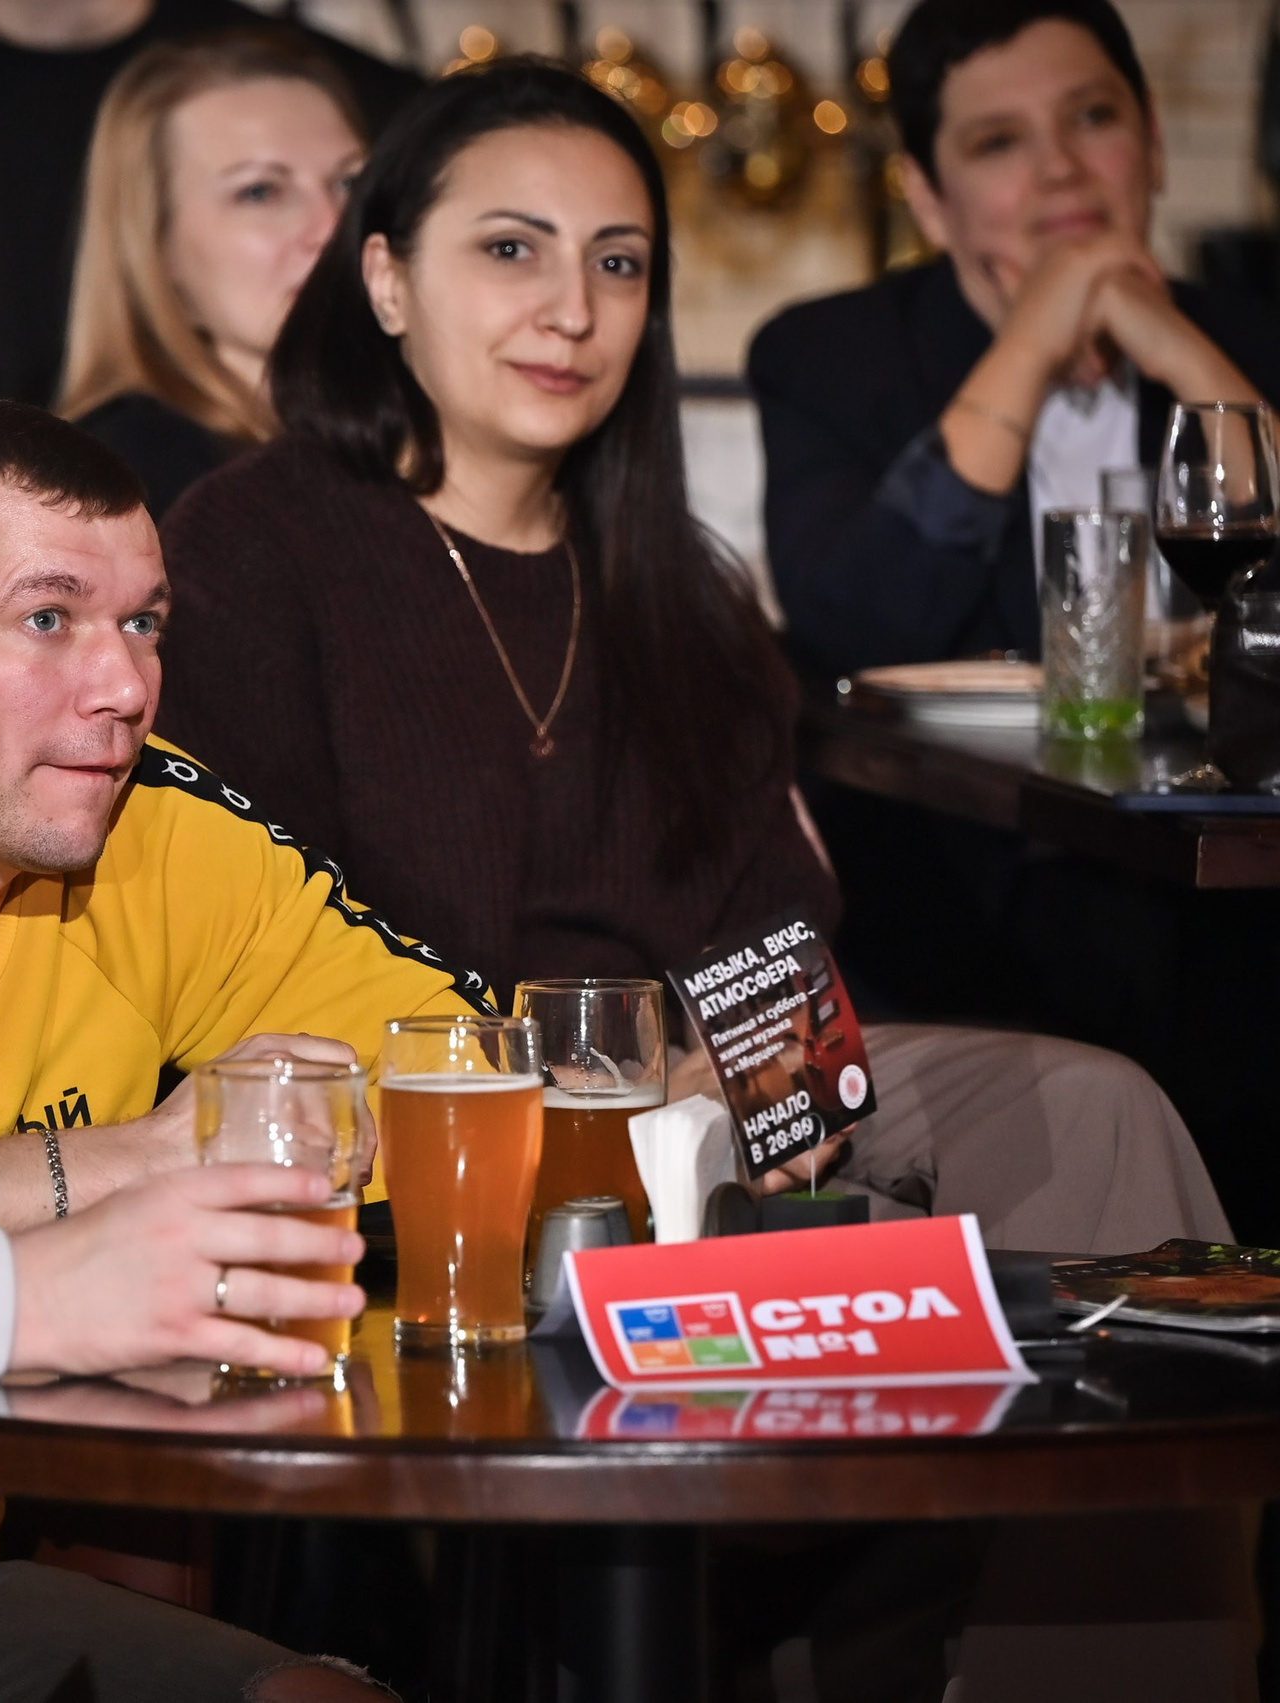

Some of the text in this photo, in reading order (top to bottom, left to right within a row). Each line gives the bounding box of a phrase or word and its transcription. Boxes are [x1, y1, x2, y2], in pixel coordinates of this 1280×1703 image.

[683, 920, 816, 998] МУЗЫКА, ВКУС,
[697, 954, 802, 1021] АТМОСФЕРА
[710, 1017, 757, 1048] Пятница
[756, 1013, 766, 1024] и
[765, 991, 808, 1020] суббота
[718, 1017, 793, 1064] живая музыка
[743, 1090, 811, 1140] НАЧАЛО
[750, 1116, 814, 1165] В 20:00
[750, 1286, 960, 1330] СТОЛ
